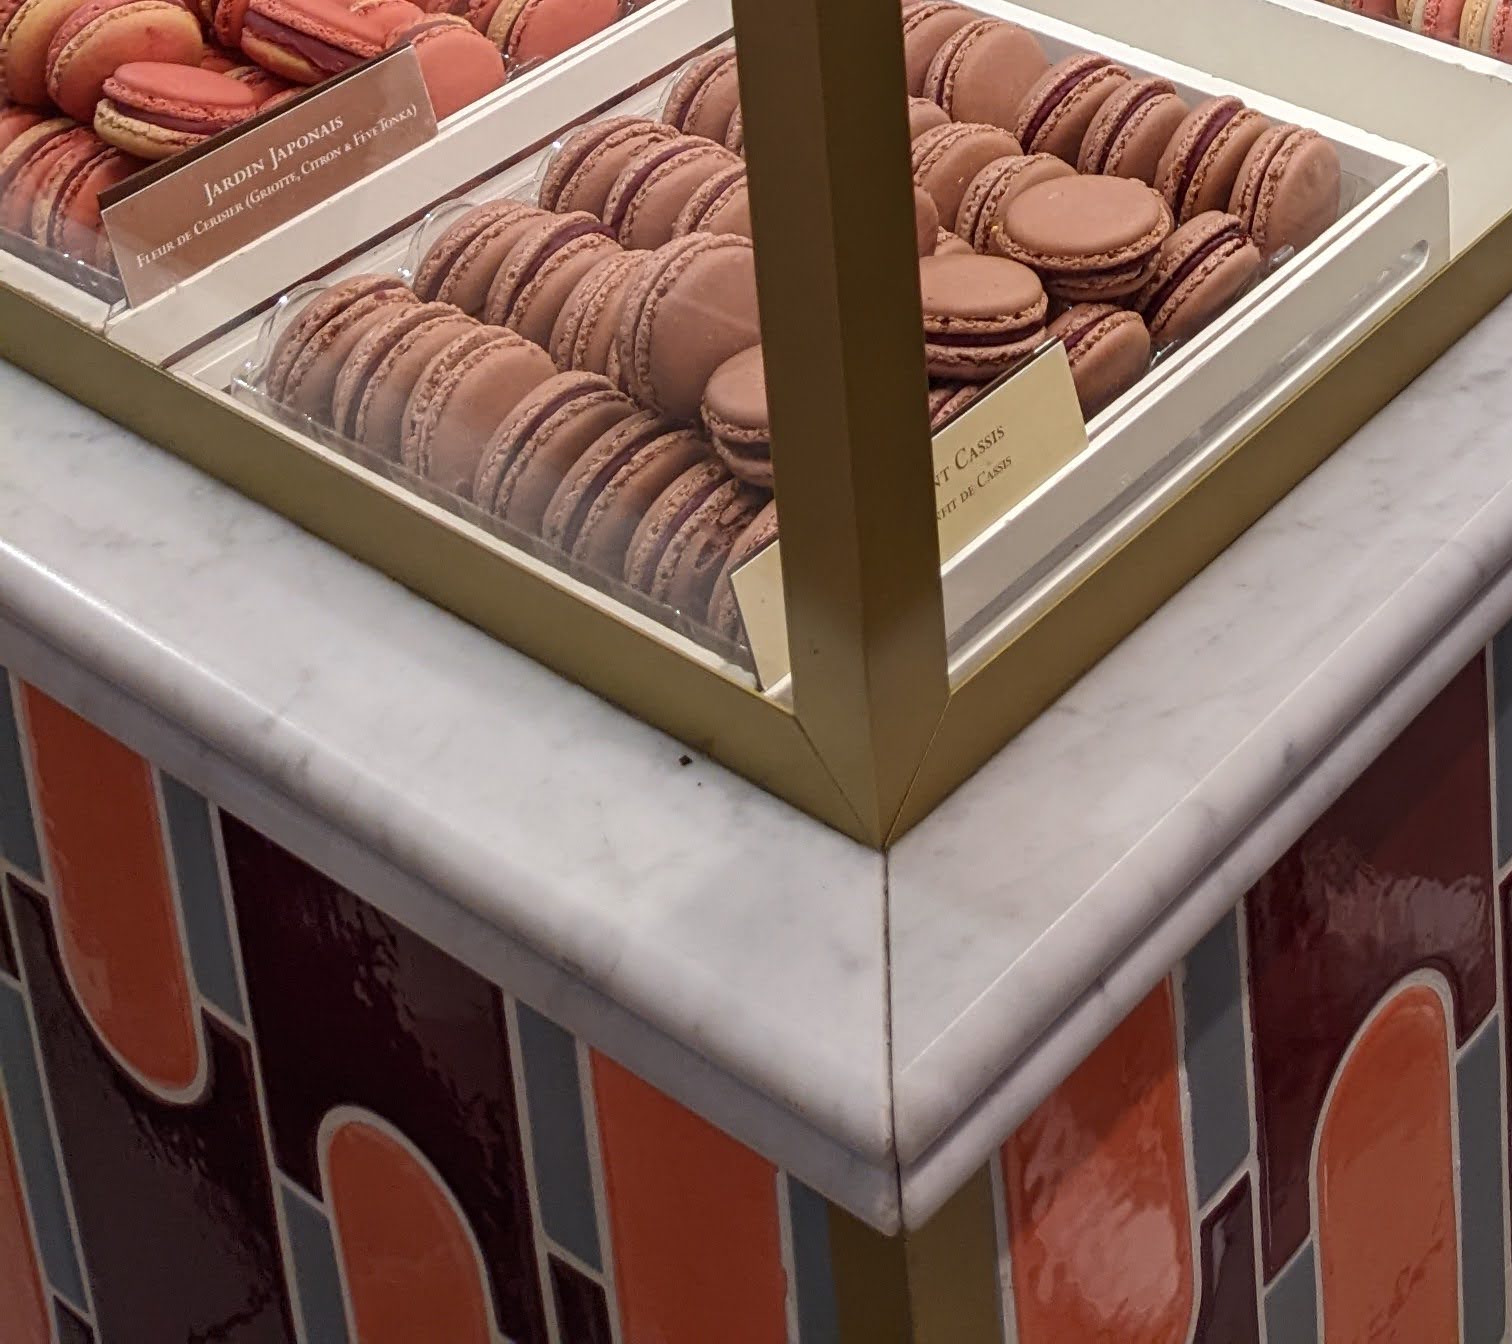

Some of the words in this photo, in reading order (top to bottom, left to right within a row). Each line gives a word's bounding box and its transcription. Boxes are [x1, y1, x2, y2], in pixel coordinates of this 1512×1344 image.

[135, 240, 175, 268] FLEUR
[176, 230, 193, 248] DE
[193, 201, 244, 236] CERISIER
[300, 147, 342, 178] CITRON
[344, 143, 353, 153] &
[375, 103, 418, 133] TONKA)
[203, 157, 265, 207] JARDIN
[267, 115, 344, 171] JAPONAIS
[954, 425, 1005, 470] CASSIS
[960, 485, 975, 503] DE
[977, 456, 1012, 487] CASSIS
